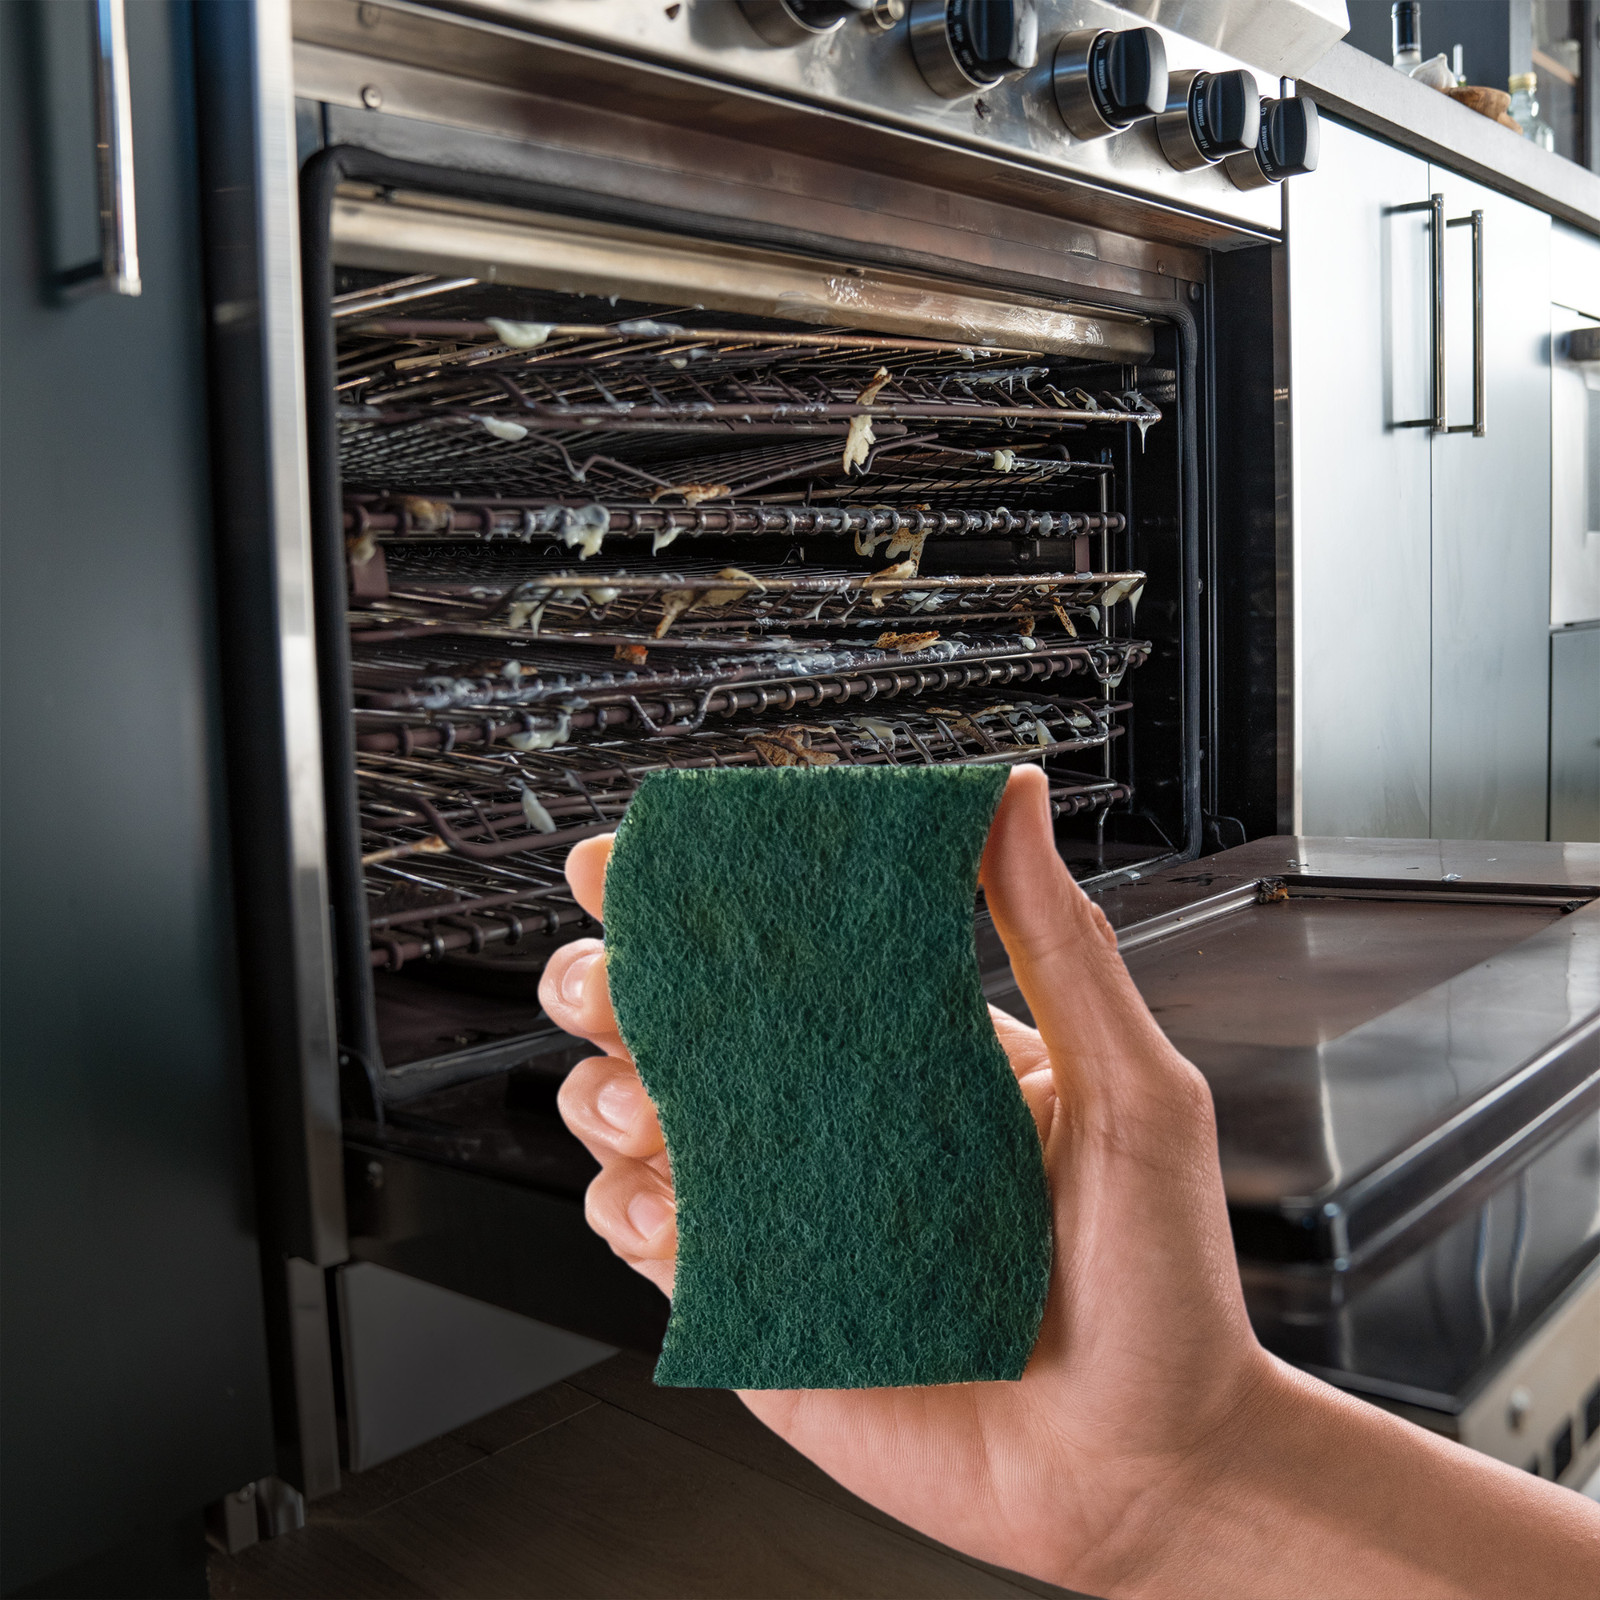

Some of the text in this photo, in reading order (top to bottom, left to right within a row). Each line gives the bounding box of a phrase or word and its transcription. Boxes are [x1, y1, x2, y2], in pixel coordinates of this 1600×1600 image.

[1096, 39, 1106, 50] LO
[1098, 59, 1107, 90] SIMMER
[1195, 80, 1204, 90] LO
[1102, 104, 1114, 115] HI
[1197, 98, 1205, 127] SIMMER
[1260, 107, 1267, 116] LO
[1261, 125, 1269, 152] SIMMER
[1200, 140, 1210, 149] HI
[1264, 164, 1273, 172] HI
